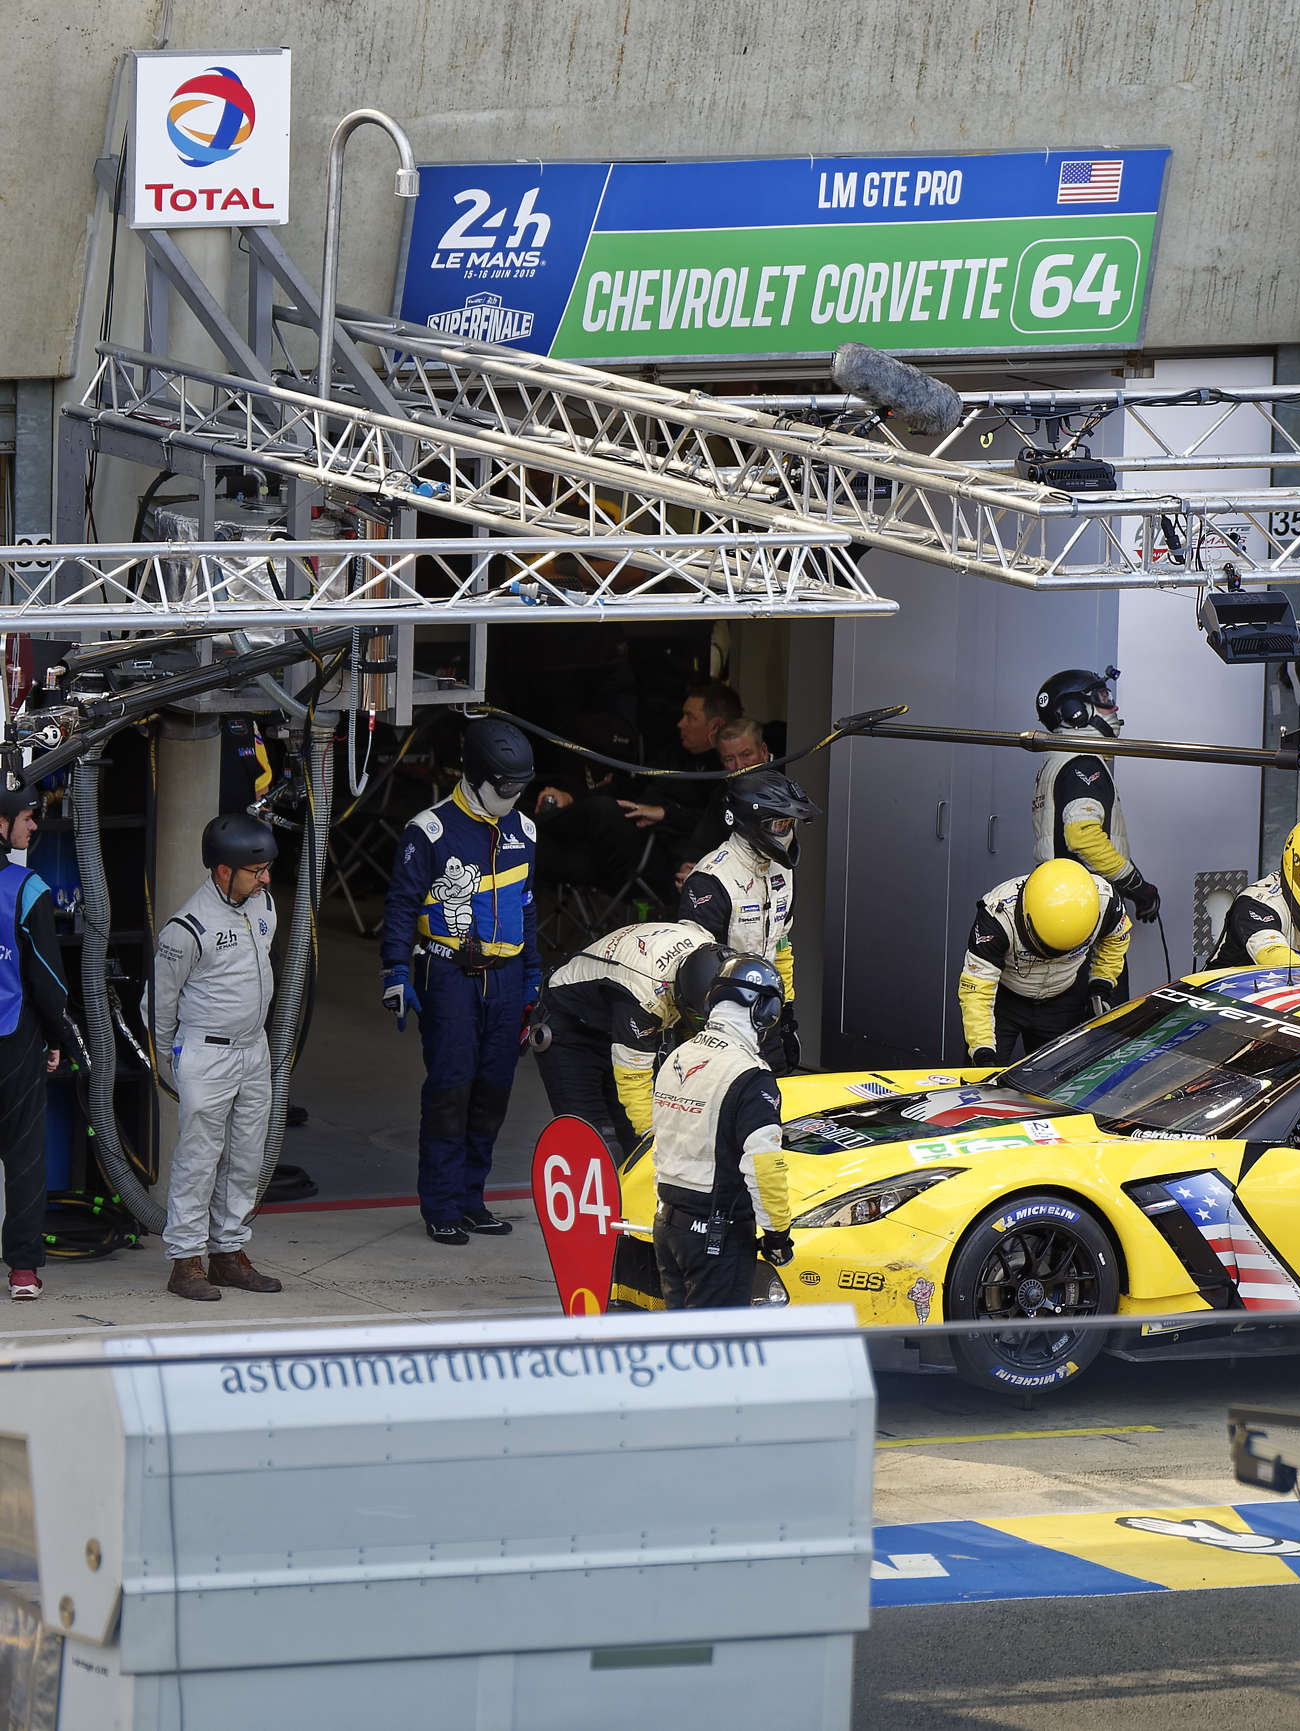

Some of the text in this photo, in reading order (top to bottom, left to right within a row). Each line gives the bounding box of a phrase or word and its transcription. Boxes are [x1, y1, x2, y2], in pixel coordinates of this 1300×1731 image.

[145, 183, 275, 212] TOTAL
[818, 170, 963, 209] LM GTE PRO
[437, 187, 551, 249] 24h
[431, 251, 541, 269] LE MANS
[464, 268, 536, 280] 15-16 JUIN 2019
[582, 252, 1122, 332] CHEVROLET CORVETTE 64
[429, 307, 532, 344] SUPERFINALE
[216, 929, 238, 946] 24h
[656, 938, 694, 972] BURKE
[654, 1091, 706, 1107] CORVETTE
[654, 1099, 703, 1114] RACING
[543, 1153, 612, 1236] 64
[1015, 1205, 1076, 1220] MICHELIN
[838, 1269, 886, 1292] BBS
[220, 1337, 768, 1395] astonmartinracing.com
[995, 1367, 1056, 1387] MICHELIN
